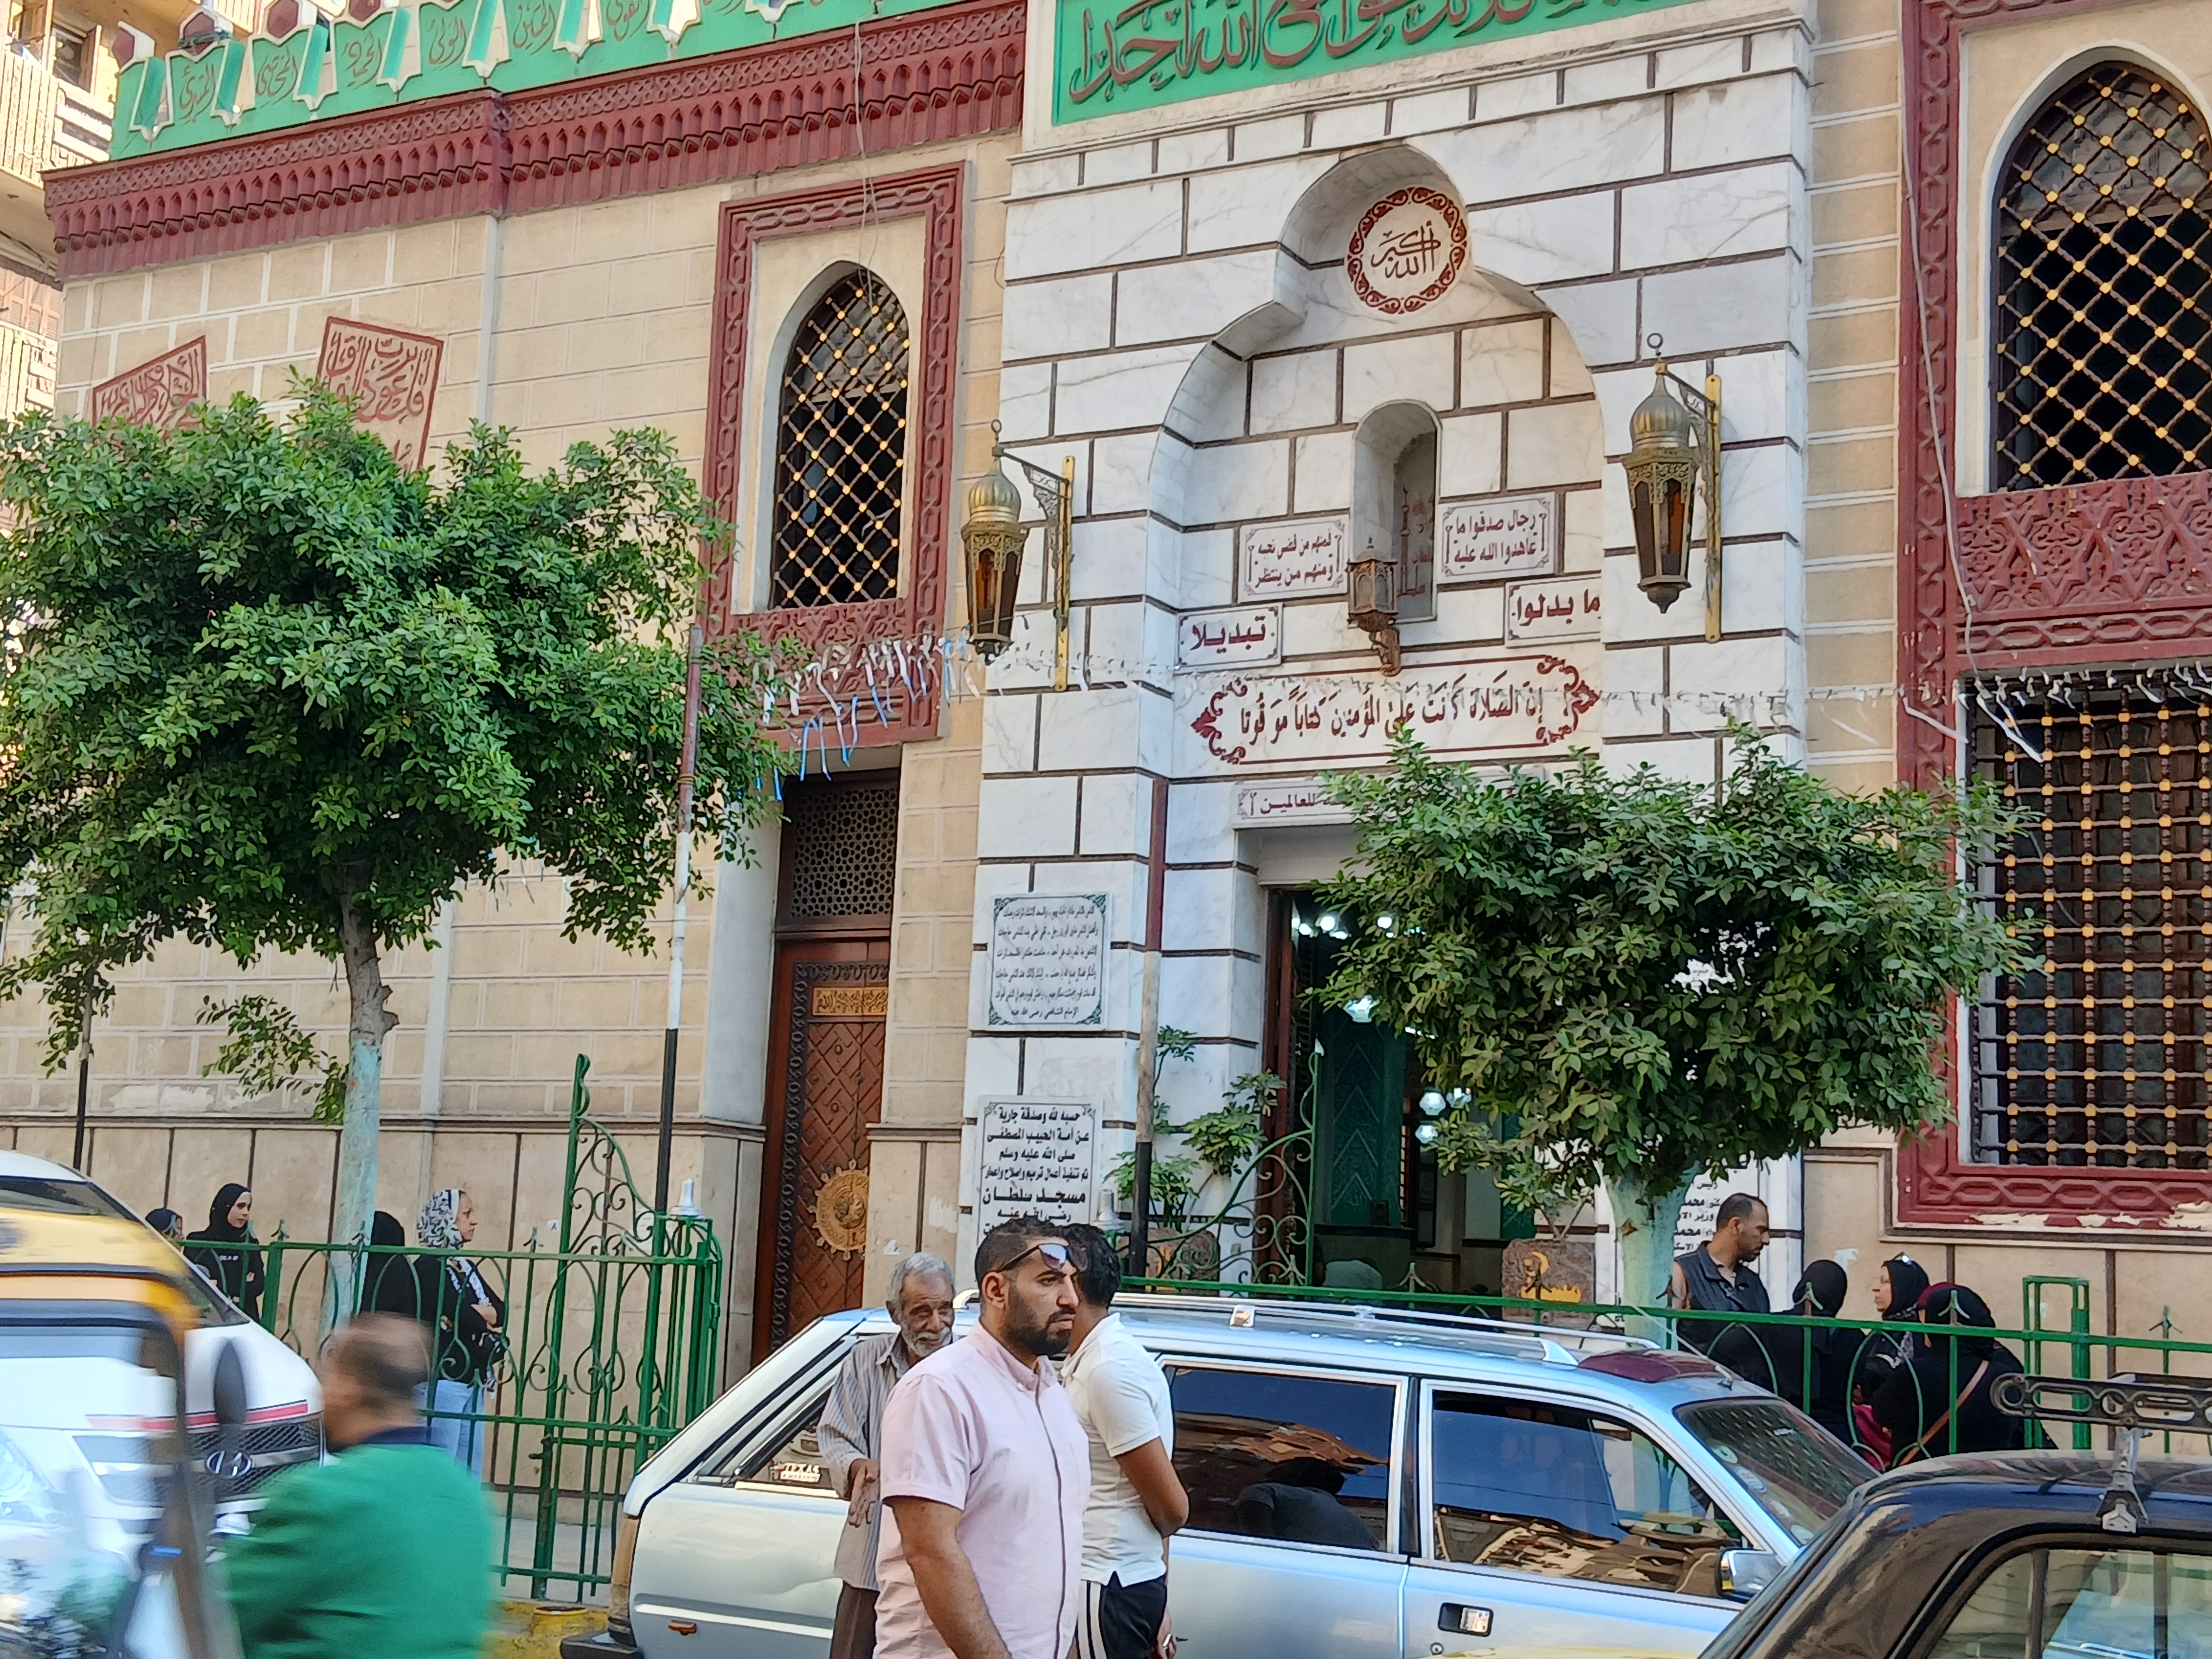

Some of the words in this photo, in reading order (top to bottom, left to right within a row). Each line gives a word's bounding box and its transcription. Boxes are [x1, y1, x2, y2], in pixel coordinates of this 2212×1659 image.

[1456, 516, 1466, 534] ما
[1469, 511, 1504, 540] صدقوا
[1508, 509, 1536, 532] رجال
[1299, 538, 1309, 557] من
[1480, 542, 1498, 561] الله
[1501, 538, 1536, 564] عاهدوا
[1255, 567, 1282, 588] ينتظر
[1284, 568, 1301, 587] من
[1304, 563, 1333, 585] ومنهم
[1517, 593, 1574, 626] بدلوا
[1189, 615, 1266, 654] تبديلا
[1026, 1129, 1055, 1144] الحبيب
[1075, 1130, 1089, 1144] عن
[999, 1147, 1018, 1161] وسلم
[1021, 1148, 1039, 1161] عليه
[1041, 1147, 1056, 1159] الله
[1057, 1149, 1076, 1162] صلى
[982, 1186, 1033, 1205] سلطان
[1036, 1187, 1086, 1208] مسجد
[998, 1207, 1019, 1217] عنه
[1023, 1207, 1043, 1218] الله
